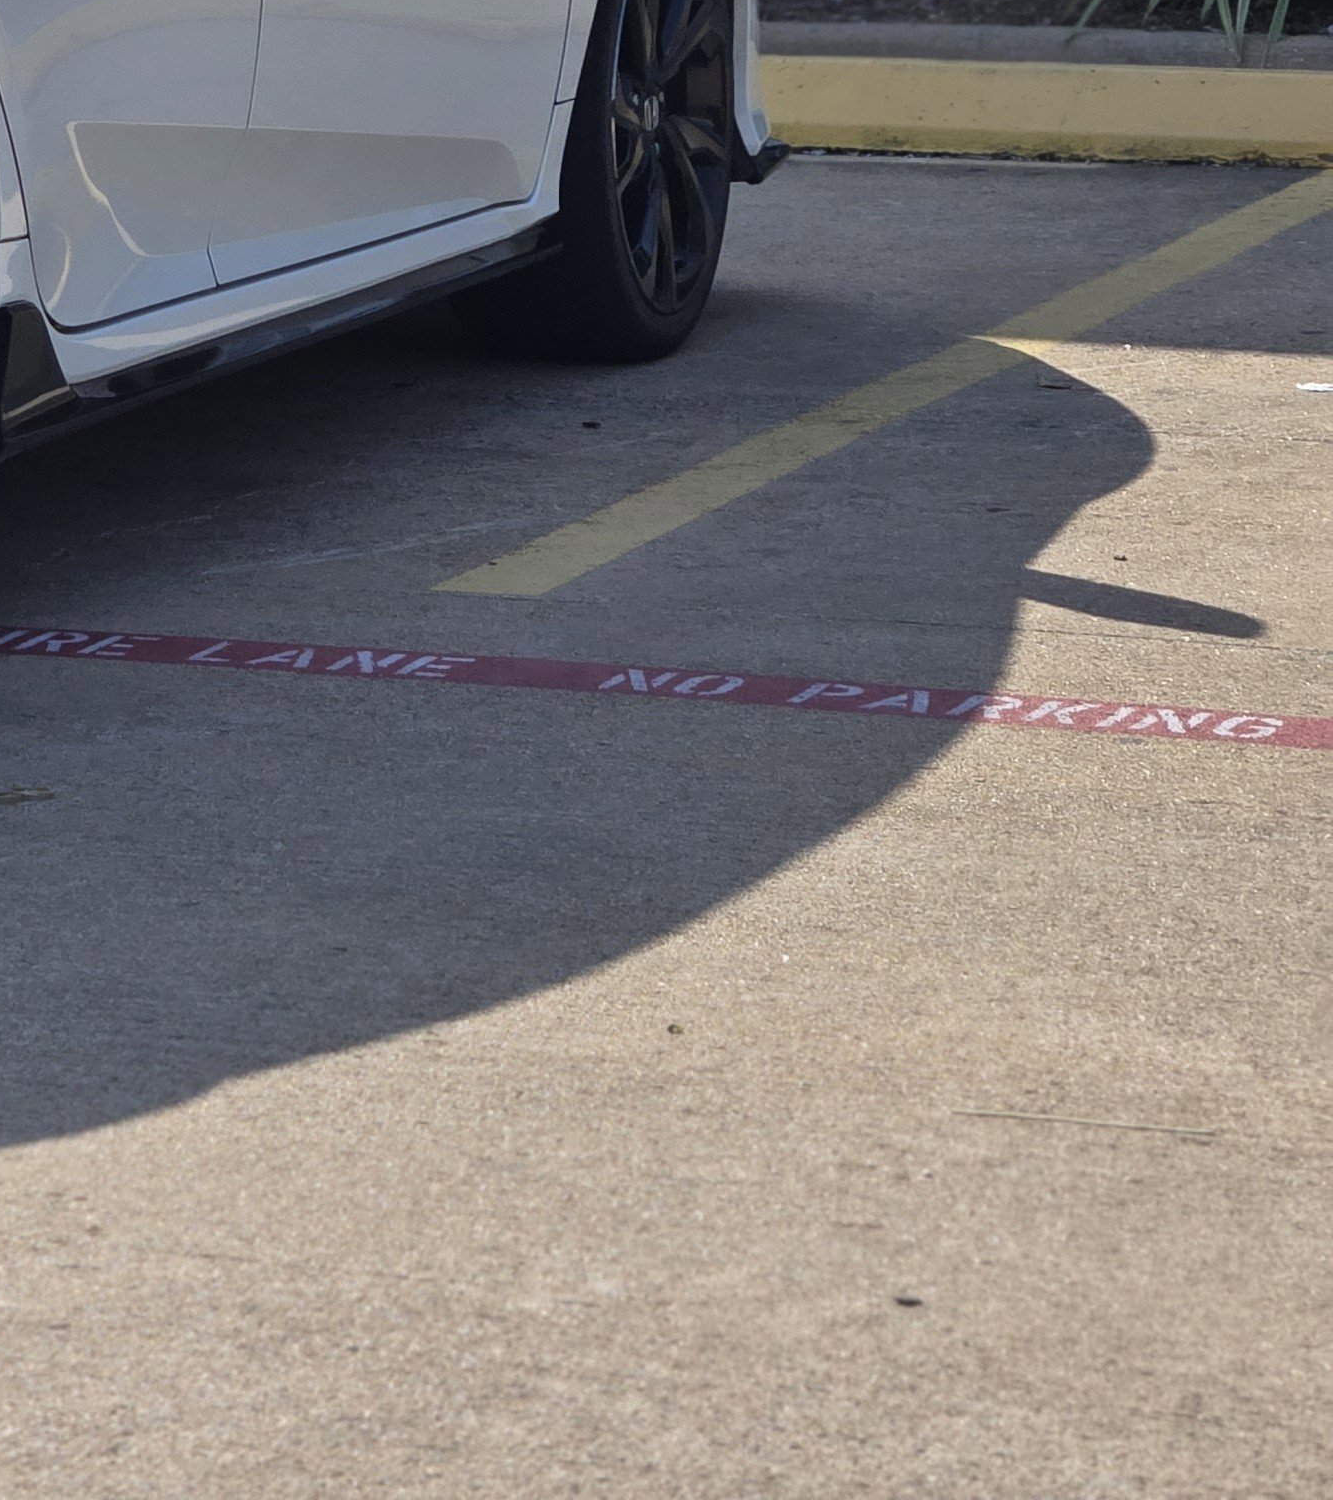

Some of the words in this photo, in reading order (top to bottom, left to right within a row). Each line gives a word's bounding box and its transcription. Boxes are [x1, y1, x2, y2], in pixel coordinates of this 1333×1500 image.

[187, 640, 475, 678] LANE
[597, 668, 745, 697] NO
[790, 681, 1284, 739] PARKING
